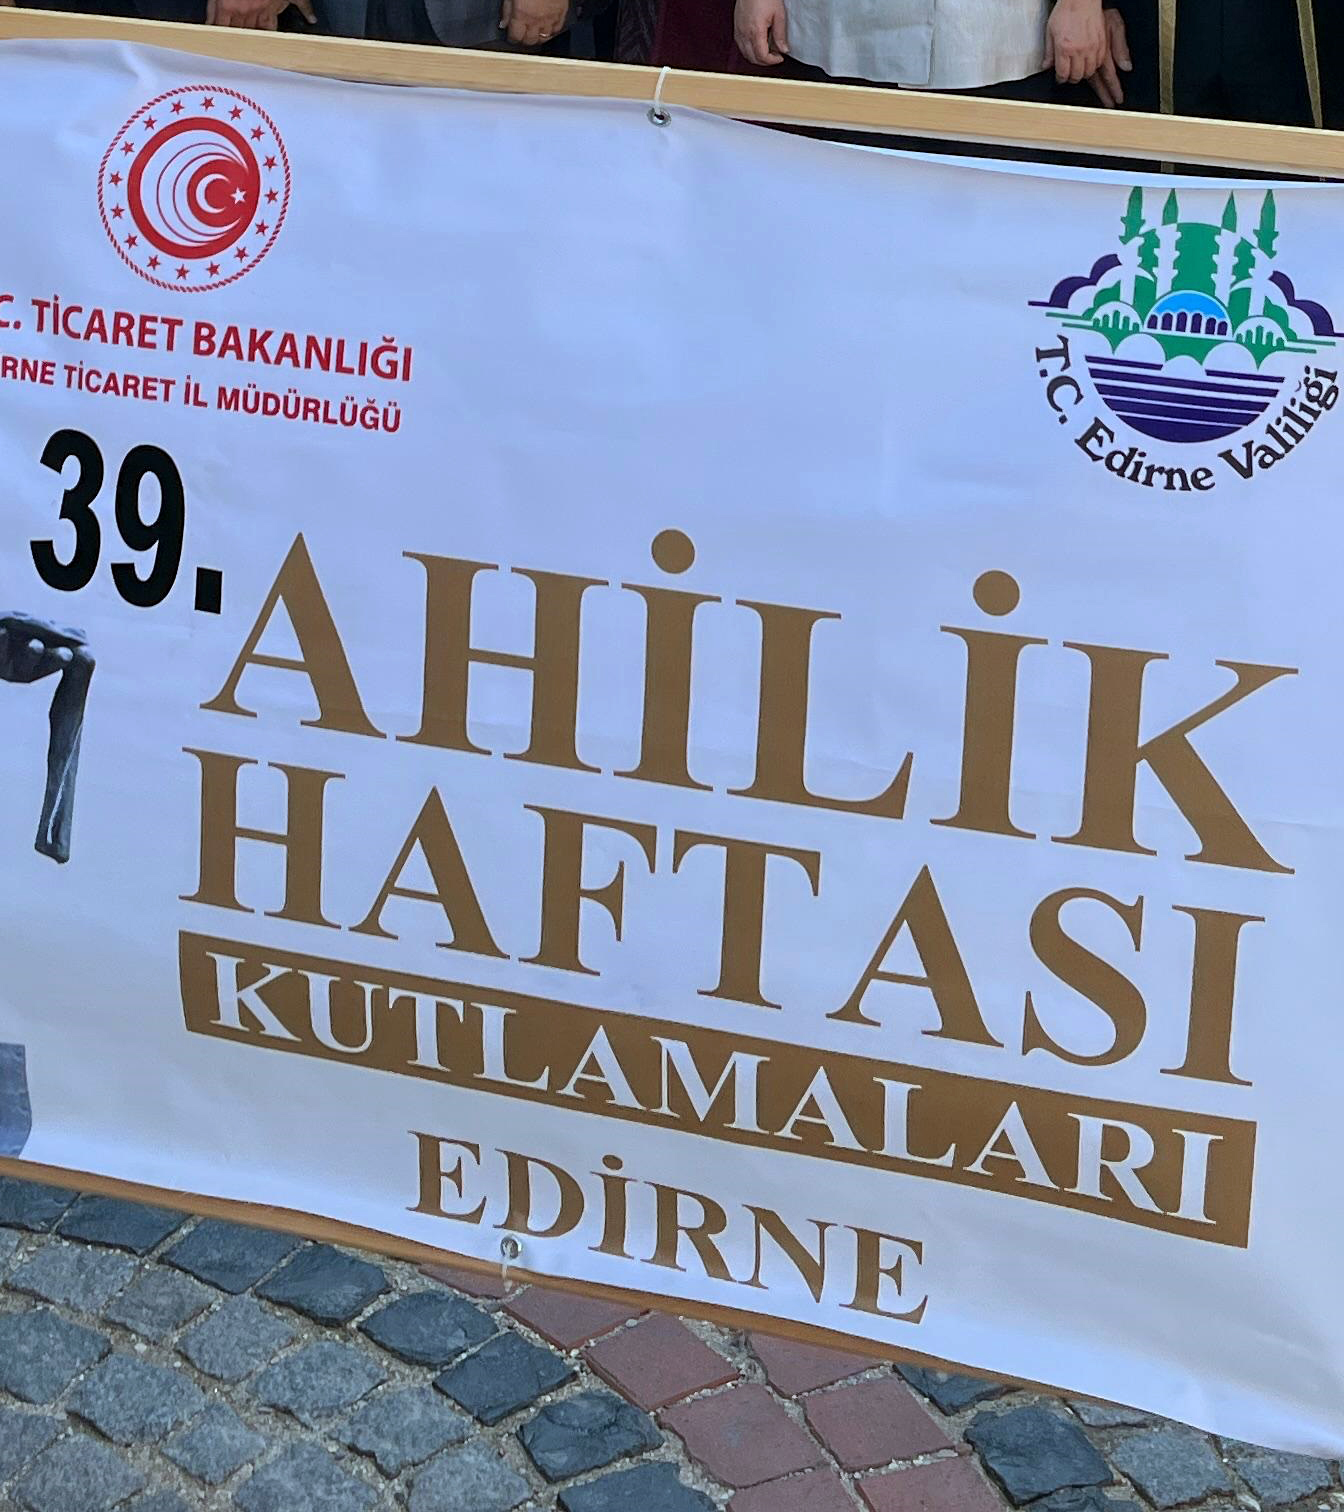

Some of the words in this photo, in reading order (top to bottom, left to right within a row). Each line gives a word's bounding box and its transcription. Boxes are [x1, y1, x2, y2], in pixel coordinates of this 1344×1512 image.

[31, 294, 184, 353] TİCARET
[192, 321, 413, 382] BAKANLIĞI
[63, 361, 176, 403] TİCARET
[183, 374, 208, 409] İL
[216, 384, 402, 434] MÜDÜRLÜĞÜ
[1034, 334, 1085, 425] T.C.
[1074, 416, 1217, 492] Edirne
[1217, 365, 1340, 480] Valiliği
[29, 428, 224, 616] 39.
[199, 527, 1299, 876] AHİLİK
[179, 746, 1266, 1086] HAFTASI
[205, 949, 1226, 1224] KUTLAMALARI
[406, 1129, 930, 1325] EDİRNE
